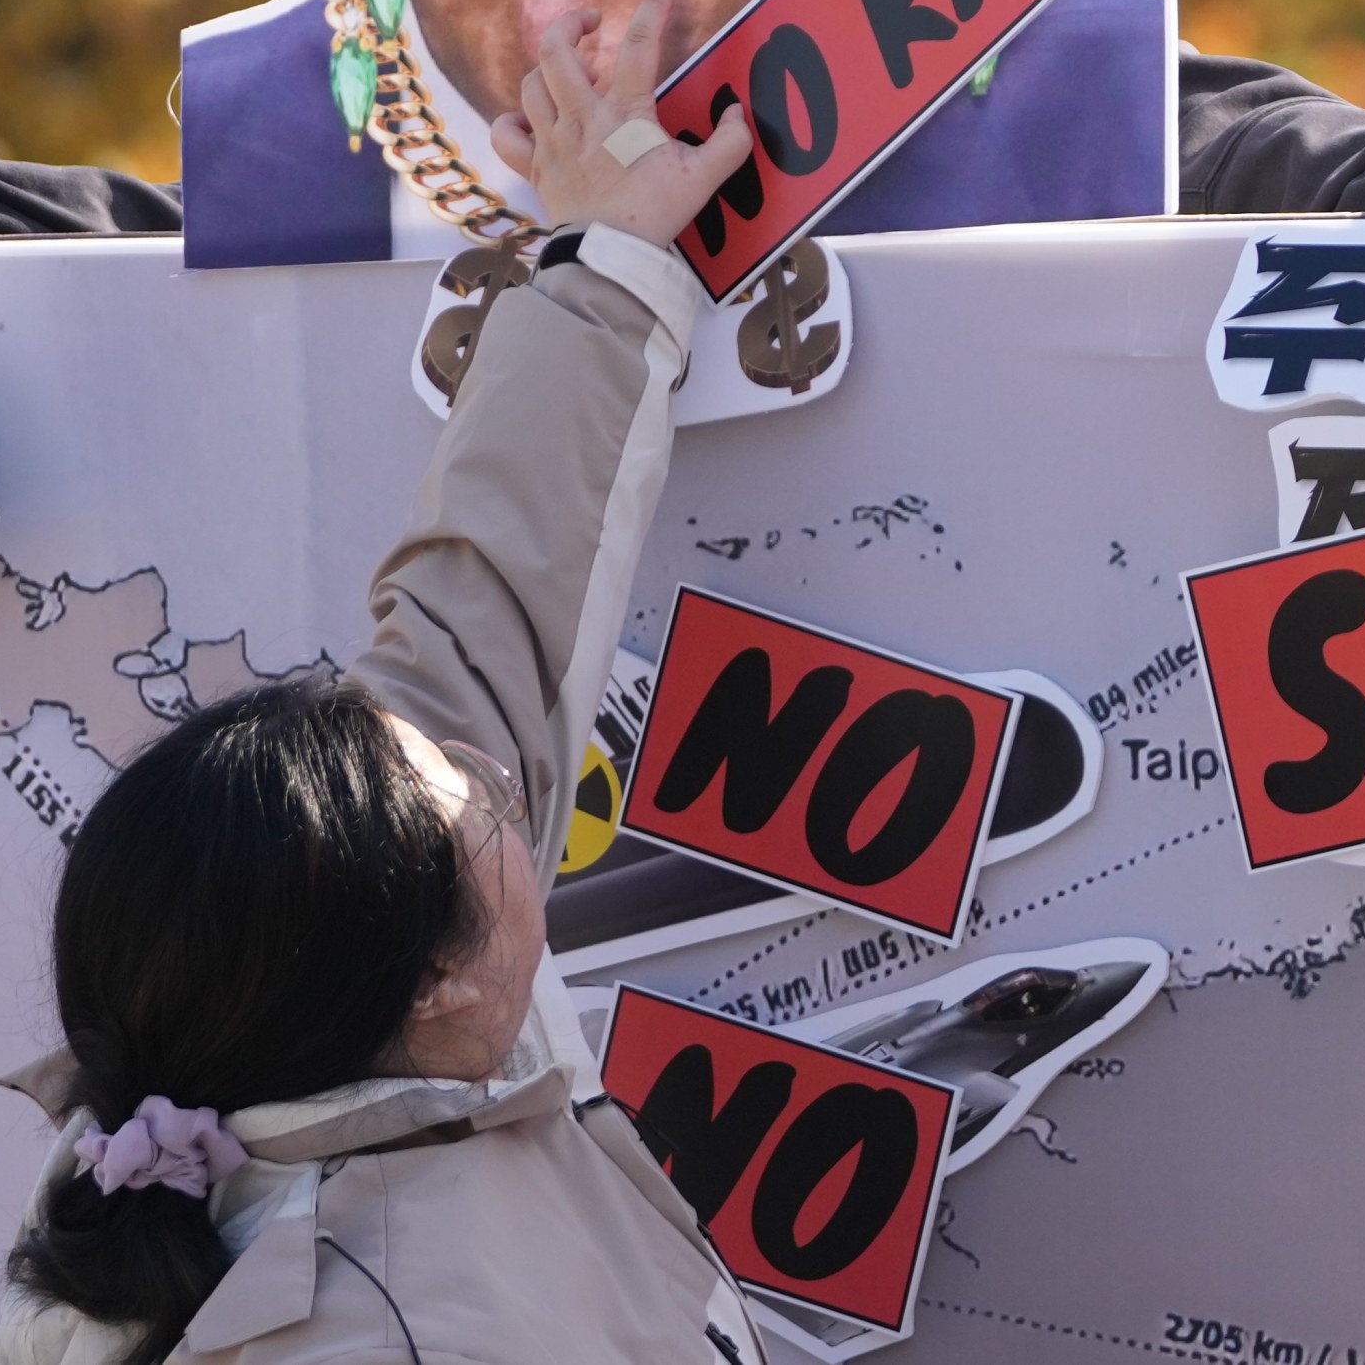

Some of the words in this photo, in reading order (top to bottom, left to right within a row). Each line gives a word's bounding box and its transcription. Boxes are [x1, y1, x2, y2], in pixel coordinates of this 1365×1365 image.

[654, 648, 975, 885] NO
[1122, 739, 1227, 790] Taip
[636, 1044, 918, 1281] NO
